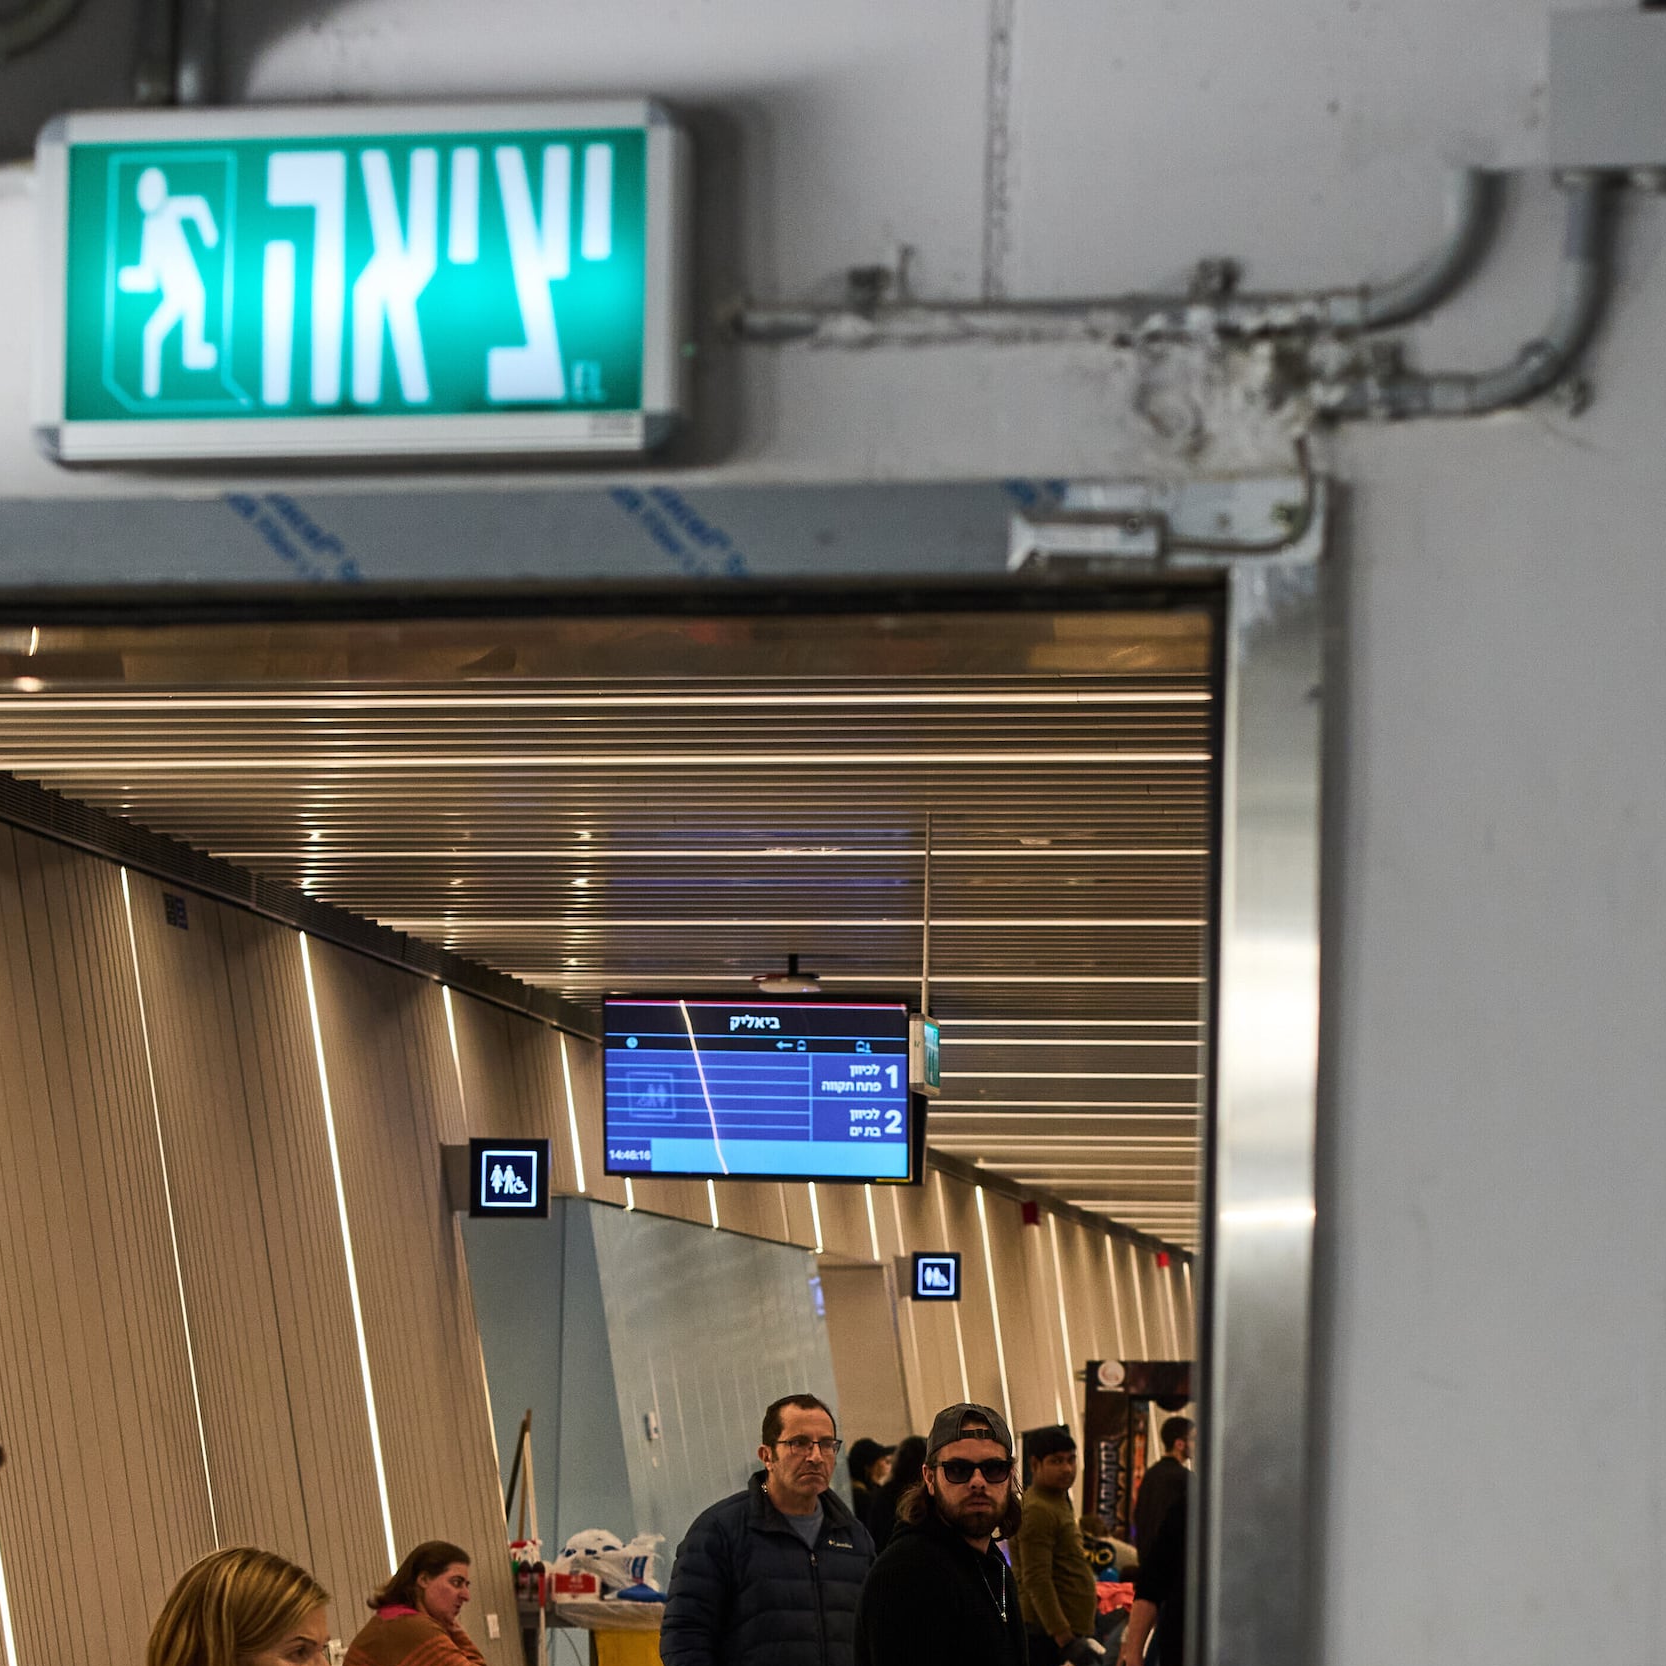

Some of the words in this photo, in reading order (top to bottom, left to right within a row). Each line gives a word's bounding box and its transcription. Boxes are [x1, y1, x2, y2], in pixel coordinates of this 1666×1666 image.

[261, 142, 614, 406] יציאה
[728, 1014, 781, 1032] ביאליק
[849, 1064, 881, 1078] לכיוון
[884, 1064, 898, 1089] 1
[821, 1080, 854, 1094] תקווה
[855, 1081, 882, 1092] פתח
[849, 1108, 881, 1122] לכיוון
[884, 1109, 903, 1134] 2
[849, 1126, 863, 1137] ים
[863, 1126, 882, 1137] בת
